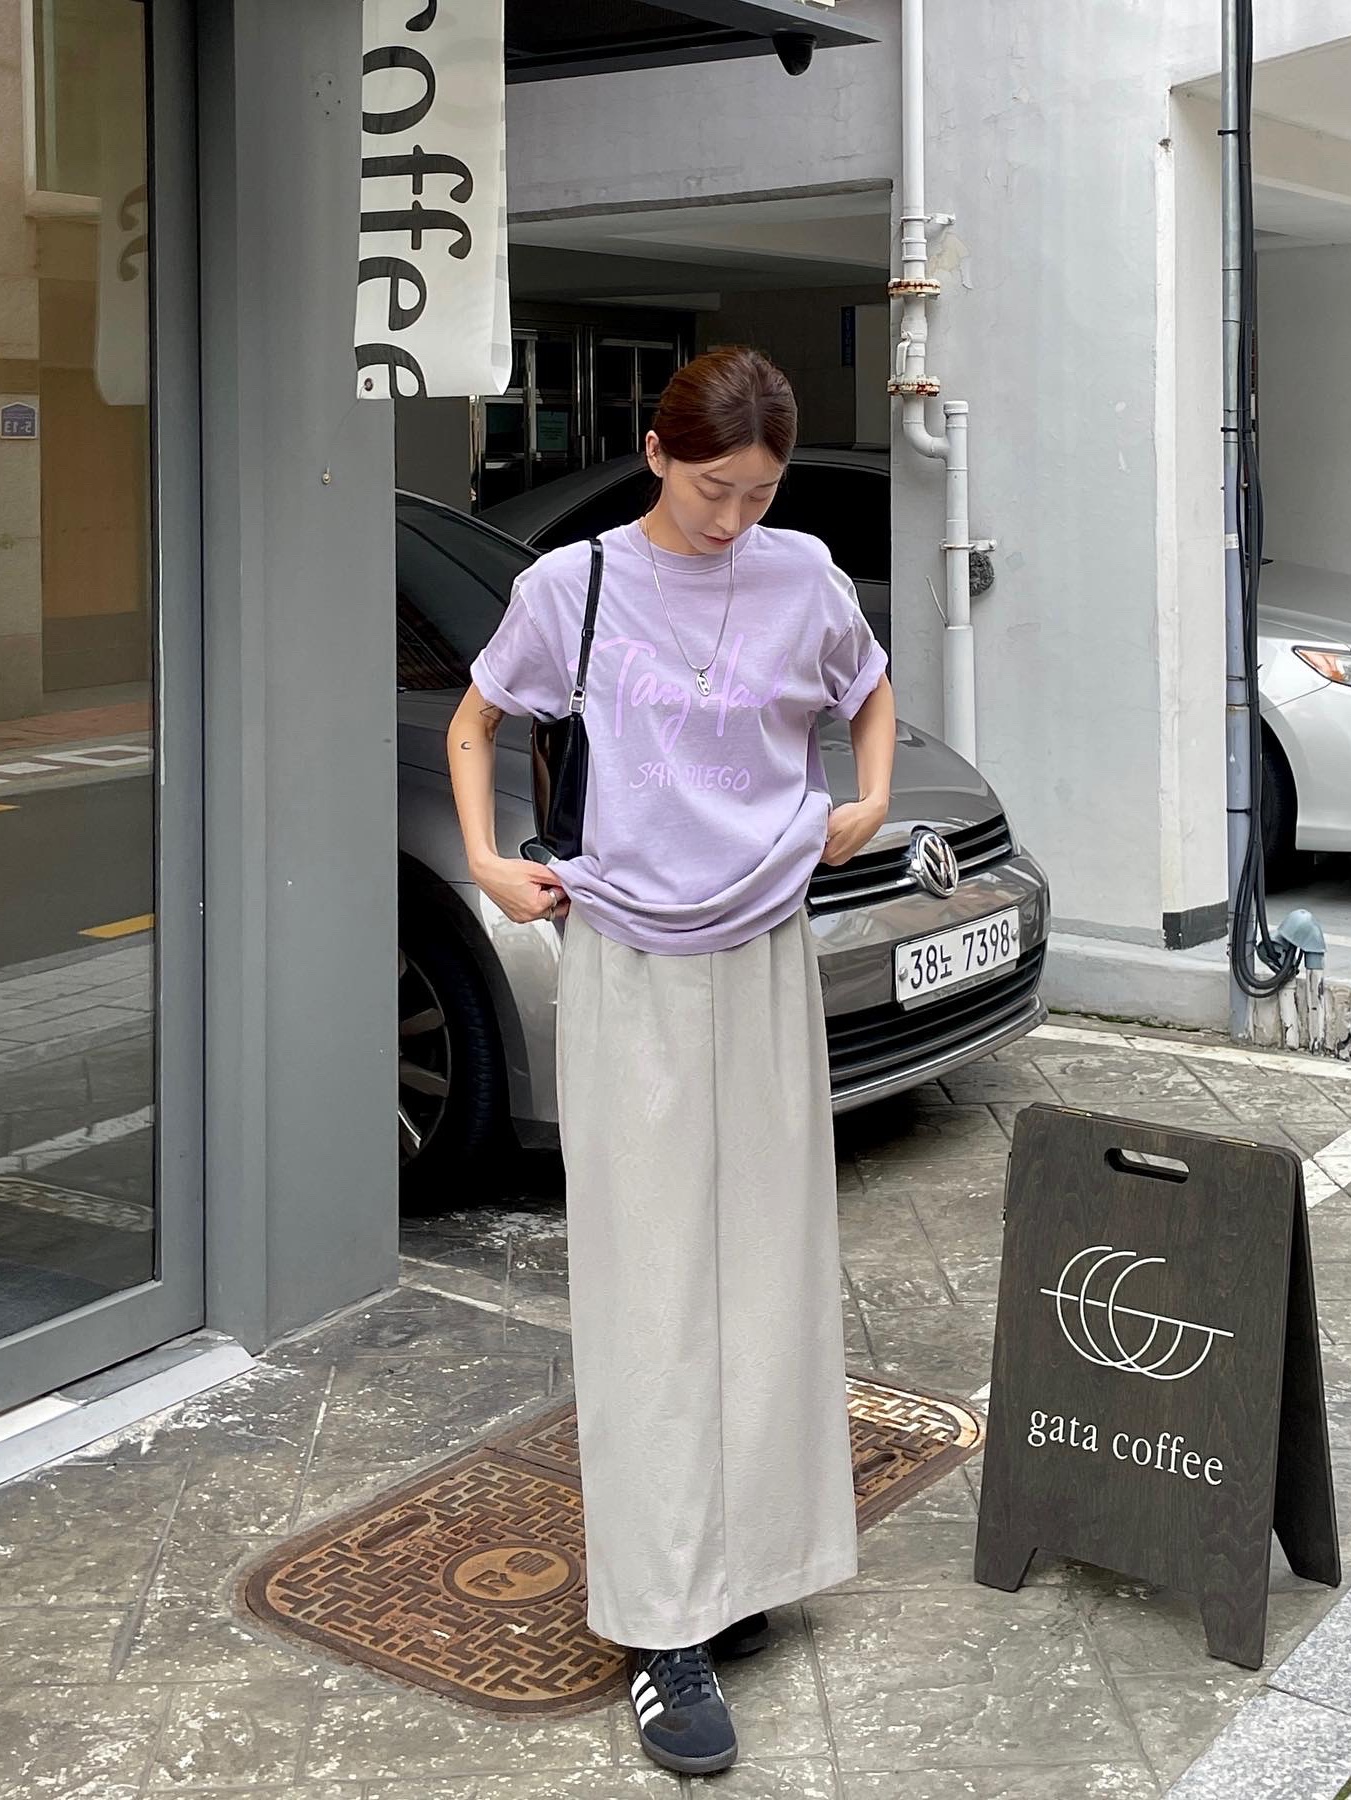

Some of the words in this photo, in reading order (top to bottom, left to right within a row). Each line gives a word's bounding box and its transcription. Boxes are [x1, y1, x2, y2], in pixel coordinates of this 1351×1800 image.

[355, 0, 473, 399] offee
[910, 944, 953, 990] 38노
[962, 919, 1010, 972] 7398
[1027, 1410, 1098, 1452] gata
[1112, 1432, 1223, 1486] coffee
